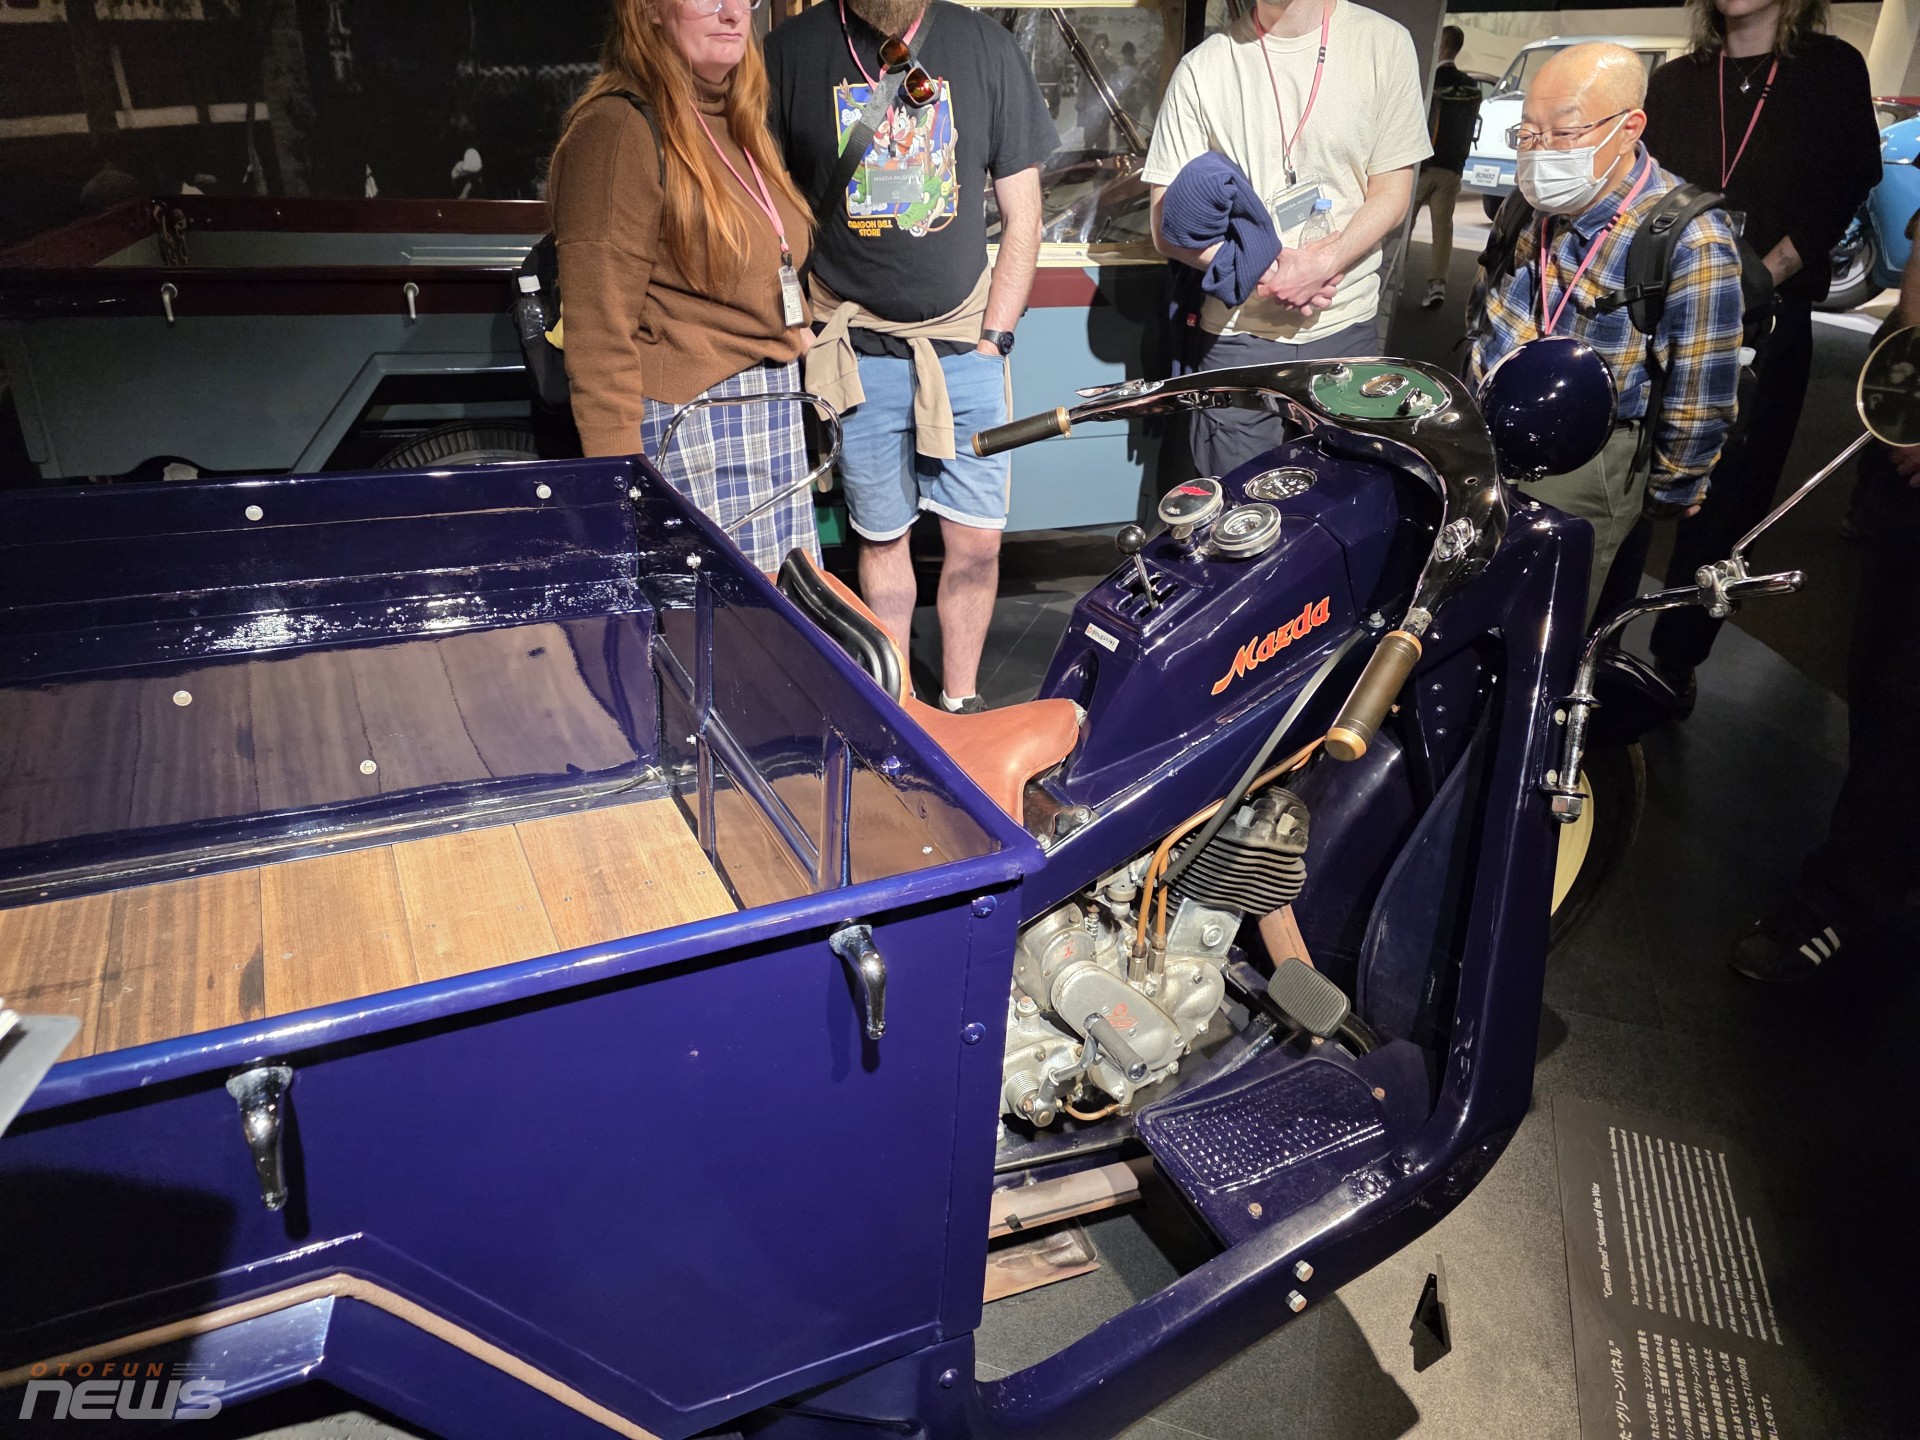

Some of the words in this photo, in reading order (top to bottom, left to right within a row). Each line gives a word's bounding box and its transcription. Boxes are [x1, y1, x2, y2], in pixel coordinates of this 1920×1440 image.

[847, 220, 877, 228] DRAGON
[858, 228, 881, 237] STORE
[1210, 595, 1331, 695] Mazda
[1591, 1182, 1600, 1196] War
[1592, 1196, 1602, 1209] the
[1593, 1207, 1603, 1217] of
[1595, 1217, 1606, 1247] Survivor
